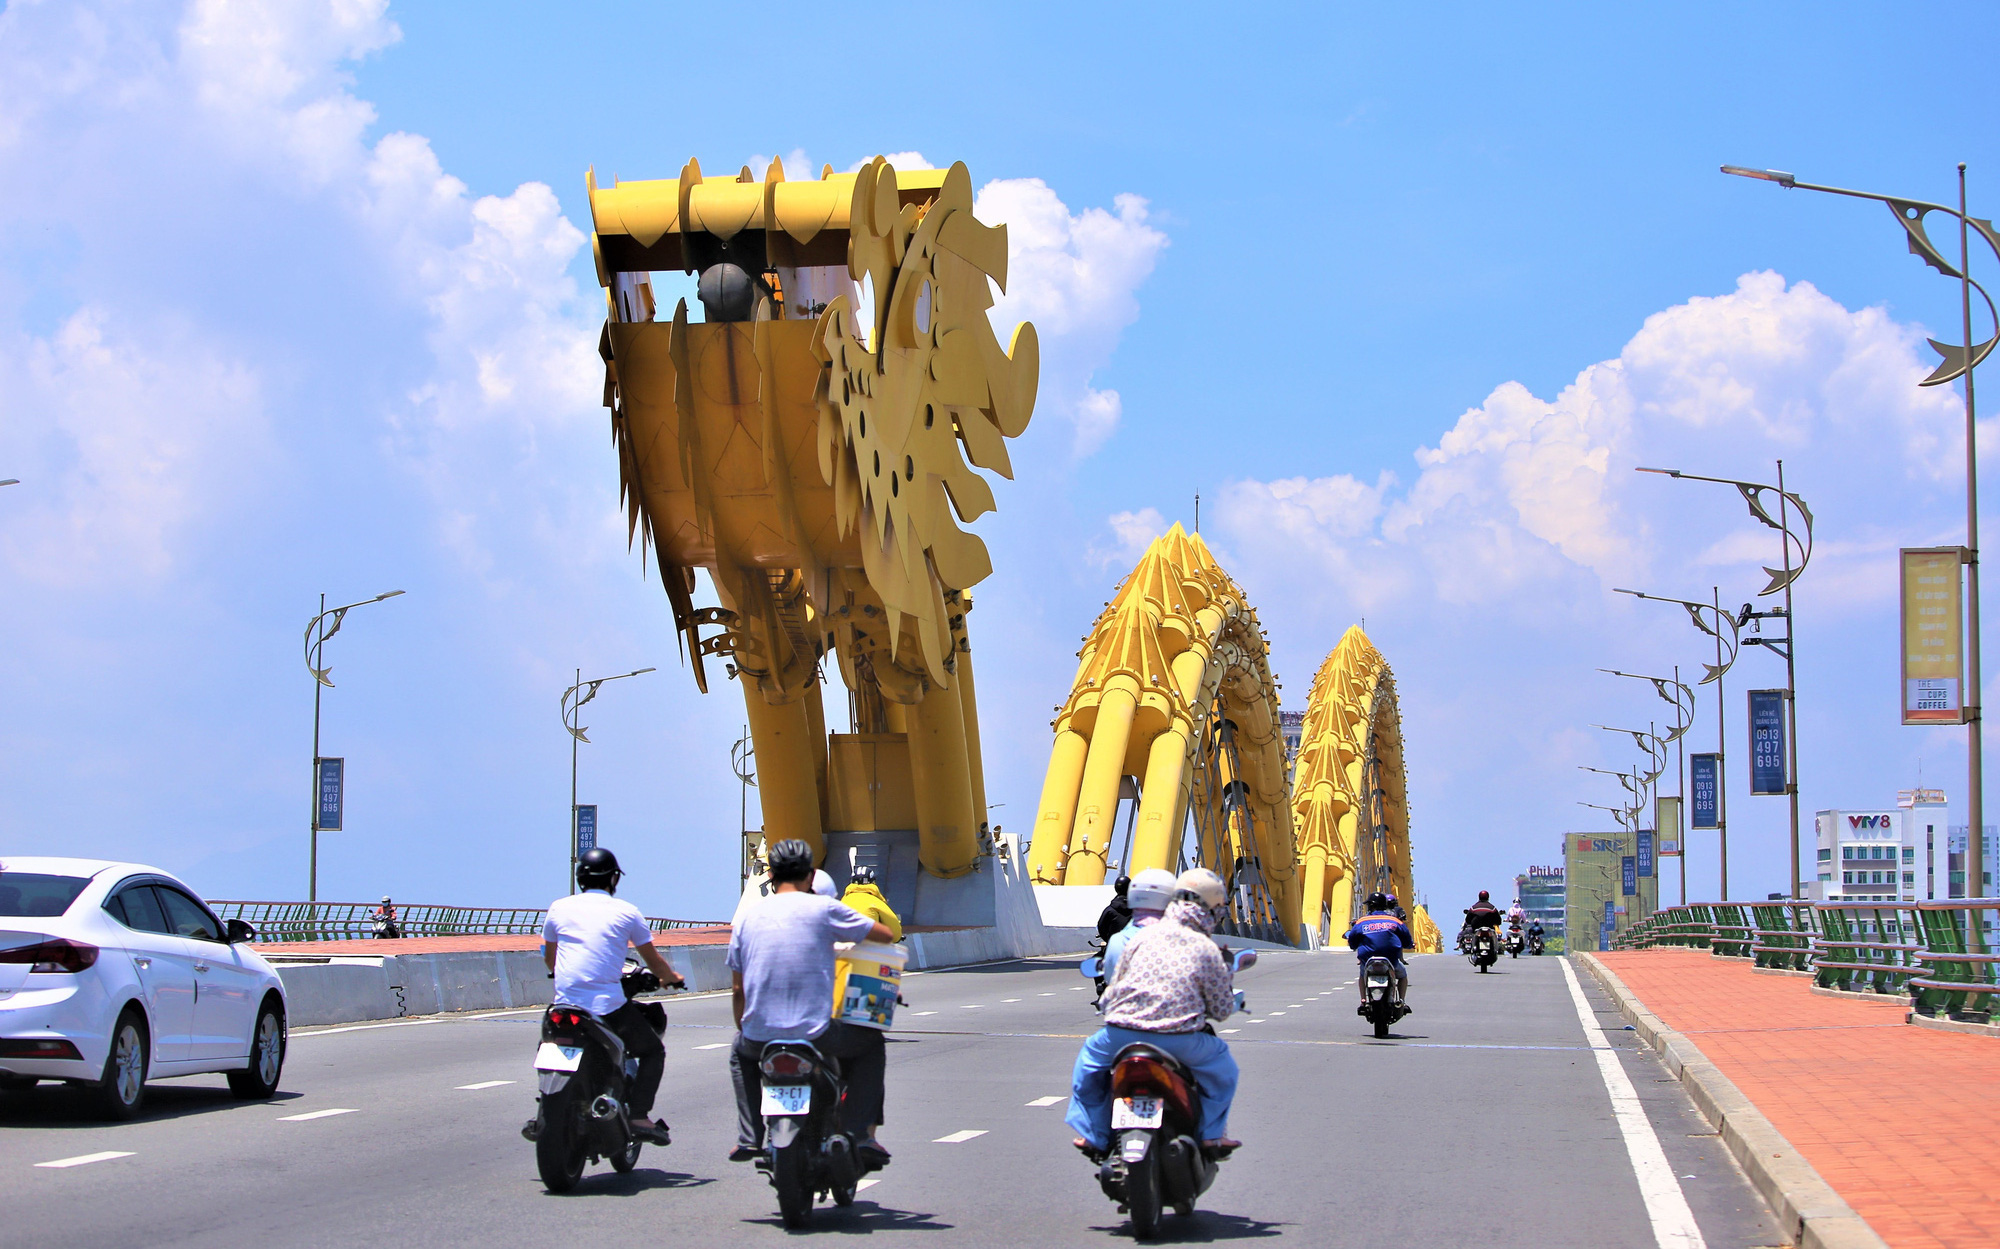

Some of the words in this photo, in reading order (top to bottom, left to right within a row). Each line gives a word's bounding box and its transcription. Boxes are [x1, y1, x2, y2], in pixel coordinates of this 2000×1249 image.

[1918, 680, 1931, 688] THE
[1918, 701, 1947, 709] COFFEE
[1756, 729, 1779, 740] 0913
[1756, 741, 1779, 754] 497
[1757, 755, 1780, 768] 695
[323, 785, 339, 793] 0913
[1696, 782, 1713, 790] 0913
[323, 793, 338, 803] 497
[1696, 790, 1713, 800] 497
[323, 803, 338, 812] 695
[1697, 800, 1714, 810] 695
[1848, 814, 1891, 829] VTV8
